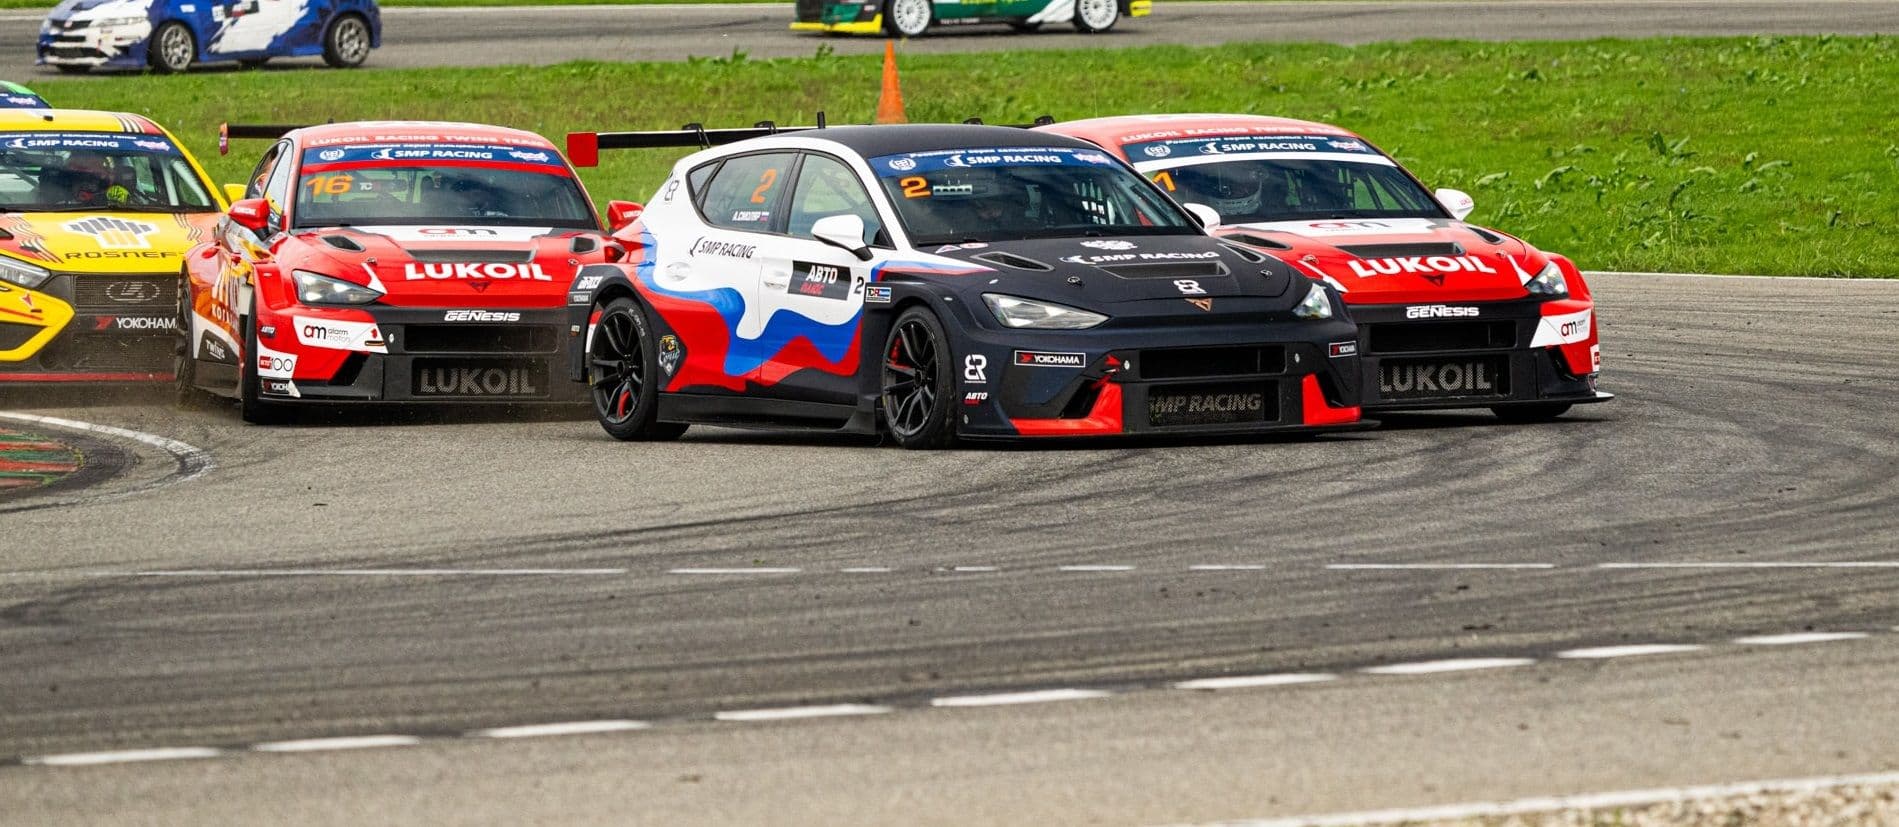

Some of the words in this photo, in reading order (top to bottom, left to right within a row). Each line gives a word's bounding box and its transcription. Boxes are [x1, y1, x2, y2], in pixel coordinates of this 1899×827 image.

[63, 140, 119, 148] RACING
[1221, 143, 1255, 151] SMP
[1258, 143, 1316, 151] RACING
[394, 150, 430, 158] SMP
[432, 150, 493, 159] RACING
[967, 155, 1001, 165] SMP
[1003, 154, 1062, 163] RACING
[305, 175, 353, 196] 16
[751, 168, 777, 204] 2
[901, 176, 931, 198] 2
[1152, 171, 1176, 191] 1
[64, 251, 184, 259] ROSNEF
[698, 240, 721, 256] SMP
[719, 243, 756, 259] RACING
[1090, 254, 1136, 262] SMP
[1140, 251, 1220, 260] RACING
[405, 263, 552, 281] LUKOIL
[1347, 256, 1496, 278] LUKOIL
[854, 276, 864, 294] 2
[444, 311, 520, 322] GENESIS
[1407, 306, 1480, 319] GENESIS
[304, 325, 326, 339] am
[1561, 321, 1578, 337] am
[1034, 354, 1080, 364] YOKOHAMA
[420, 367, 536, 395] LUKOIL
[1378, 361, 1492, 393] LUKOIL
[1188, 393, 1261, 412] RACING
